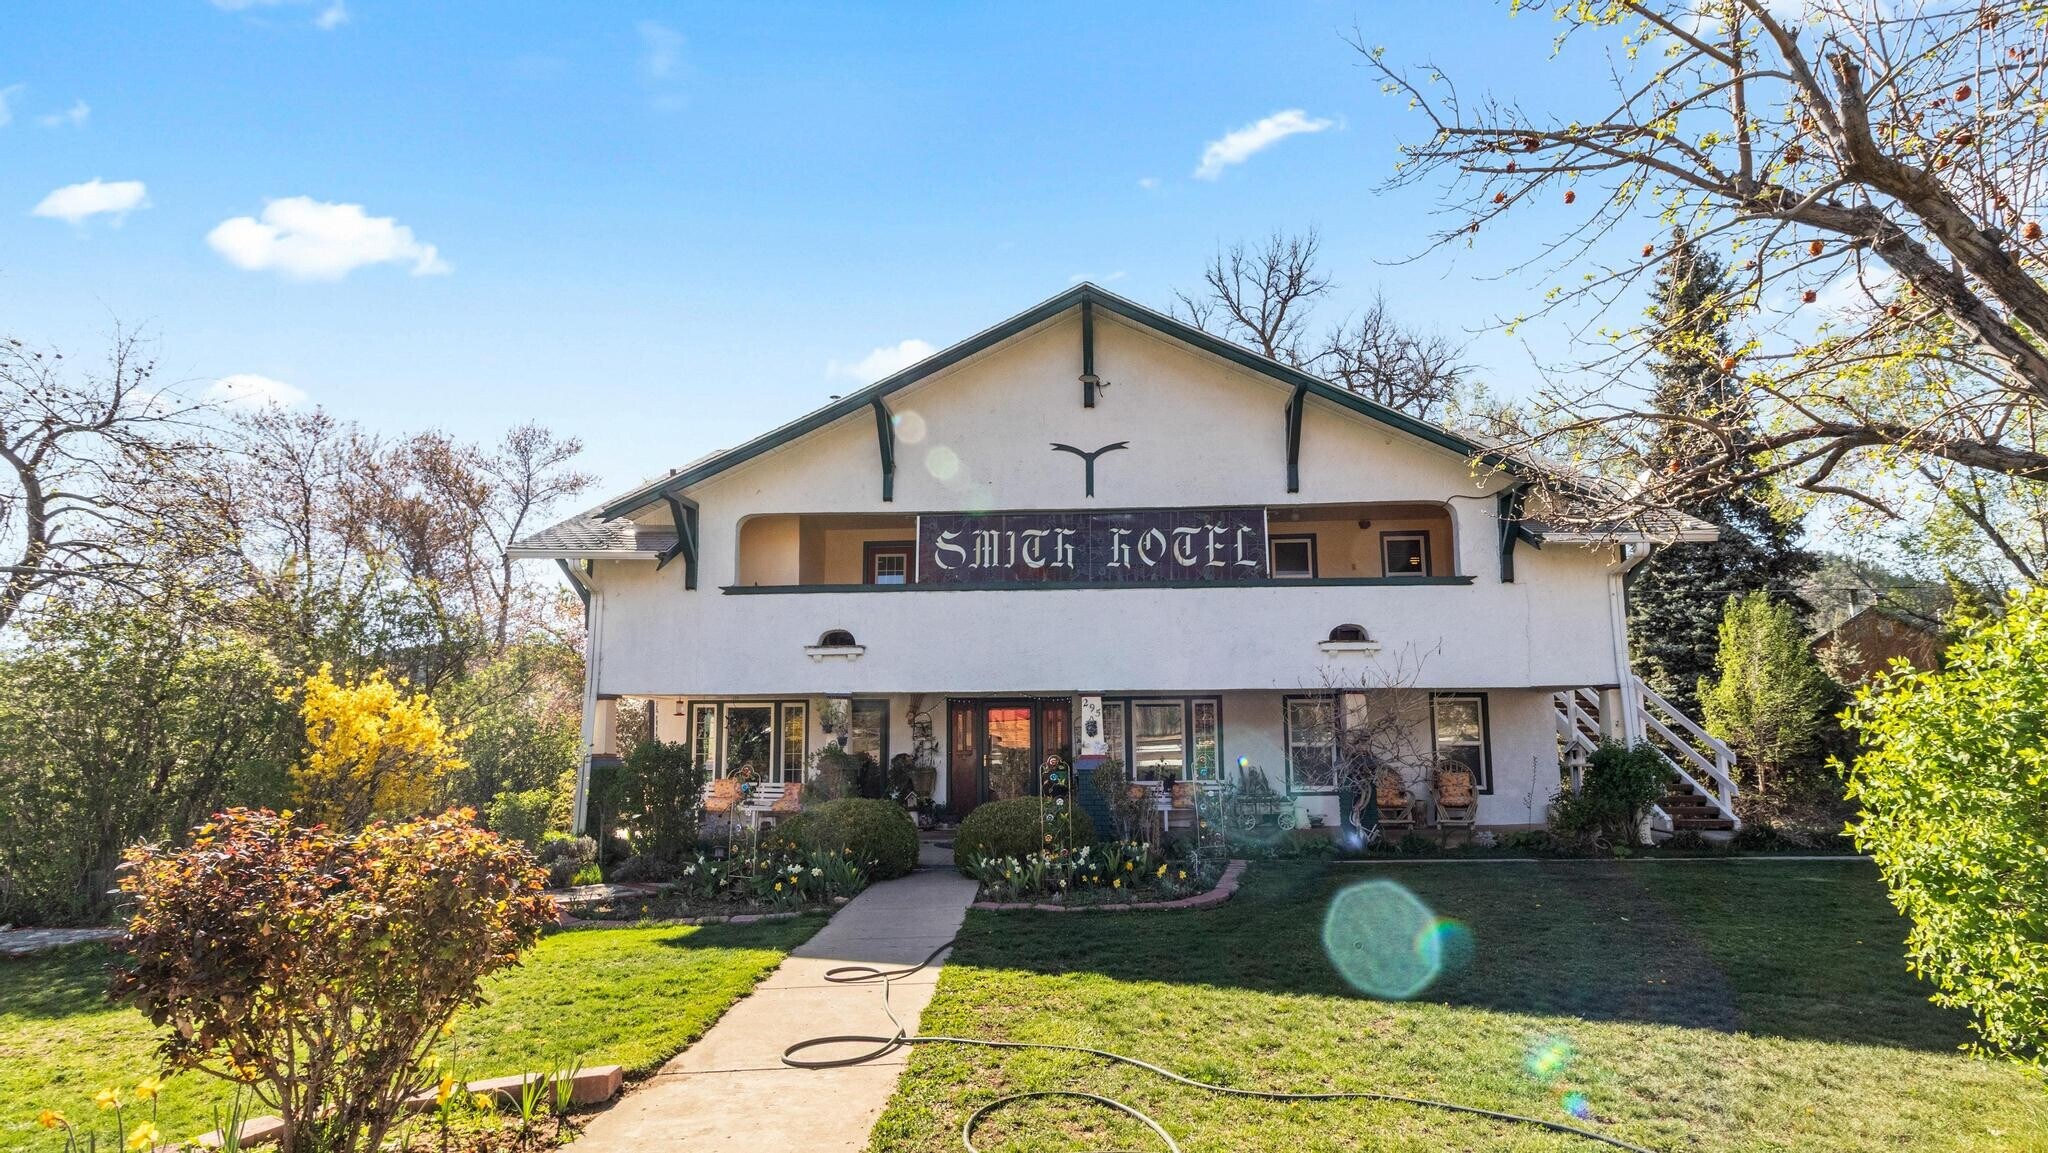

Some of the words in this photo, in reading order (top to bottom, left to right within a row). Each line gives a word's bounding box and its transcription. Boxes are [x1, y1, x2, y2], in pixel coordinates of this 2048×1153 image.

[934, 528, 1077, 570] SMITH
[1107, 522, 1258, 568] HOTEL
[1082, 698, 1101, 717] 295
